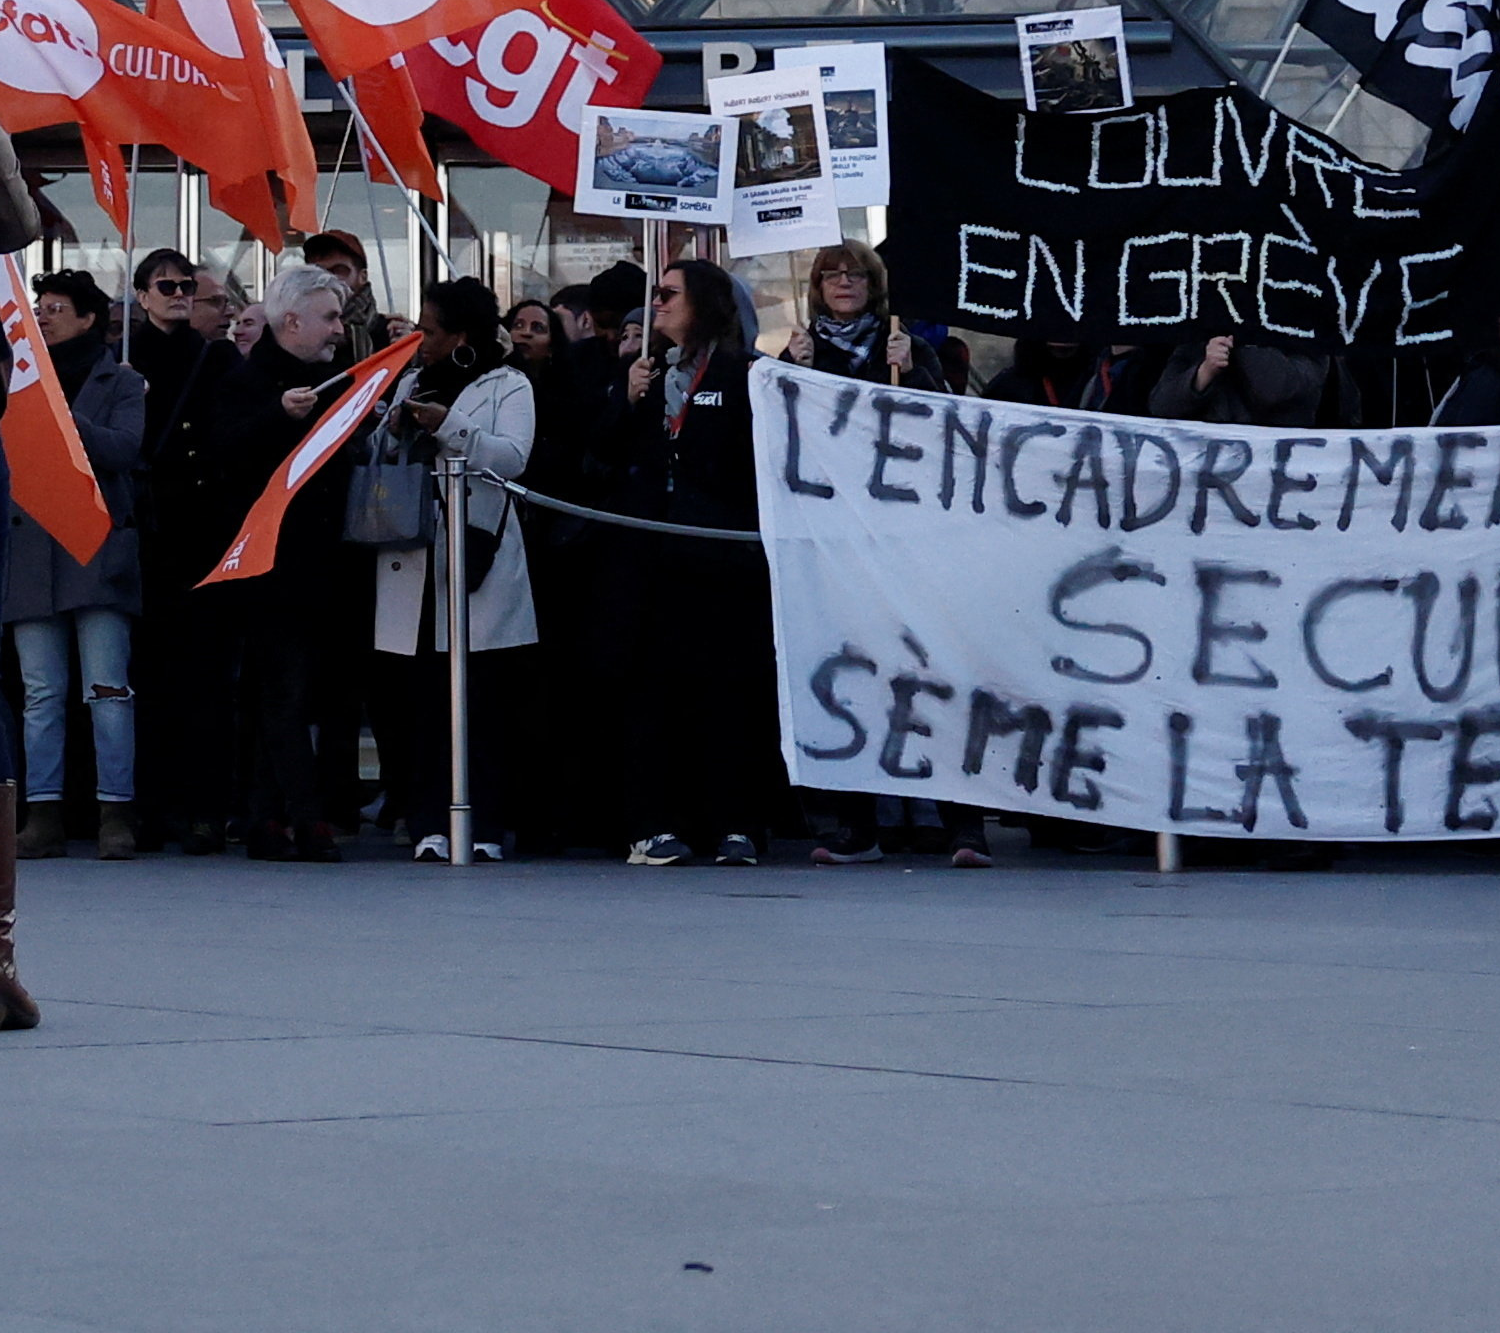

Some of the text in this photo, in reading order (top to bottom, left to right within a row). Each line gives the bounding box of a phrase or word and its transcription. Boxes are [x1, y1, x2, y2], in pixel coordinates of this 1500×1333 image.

[110, 43, 217, 89] CULTUR
[680, 201, 713, 213] SOMBRE
[1014, 96, 1420, 220] LOUVRE
[958, 203, 1463, 347] EN GRÈVE
[797, 627, 1126, 810] SÈME
[1169, 712, 1309, 832] LA
